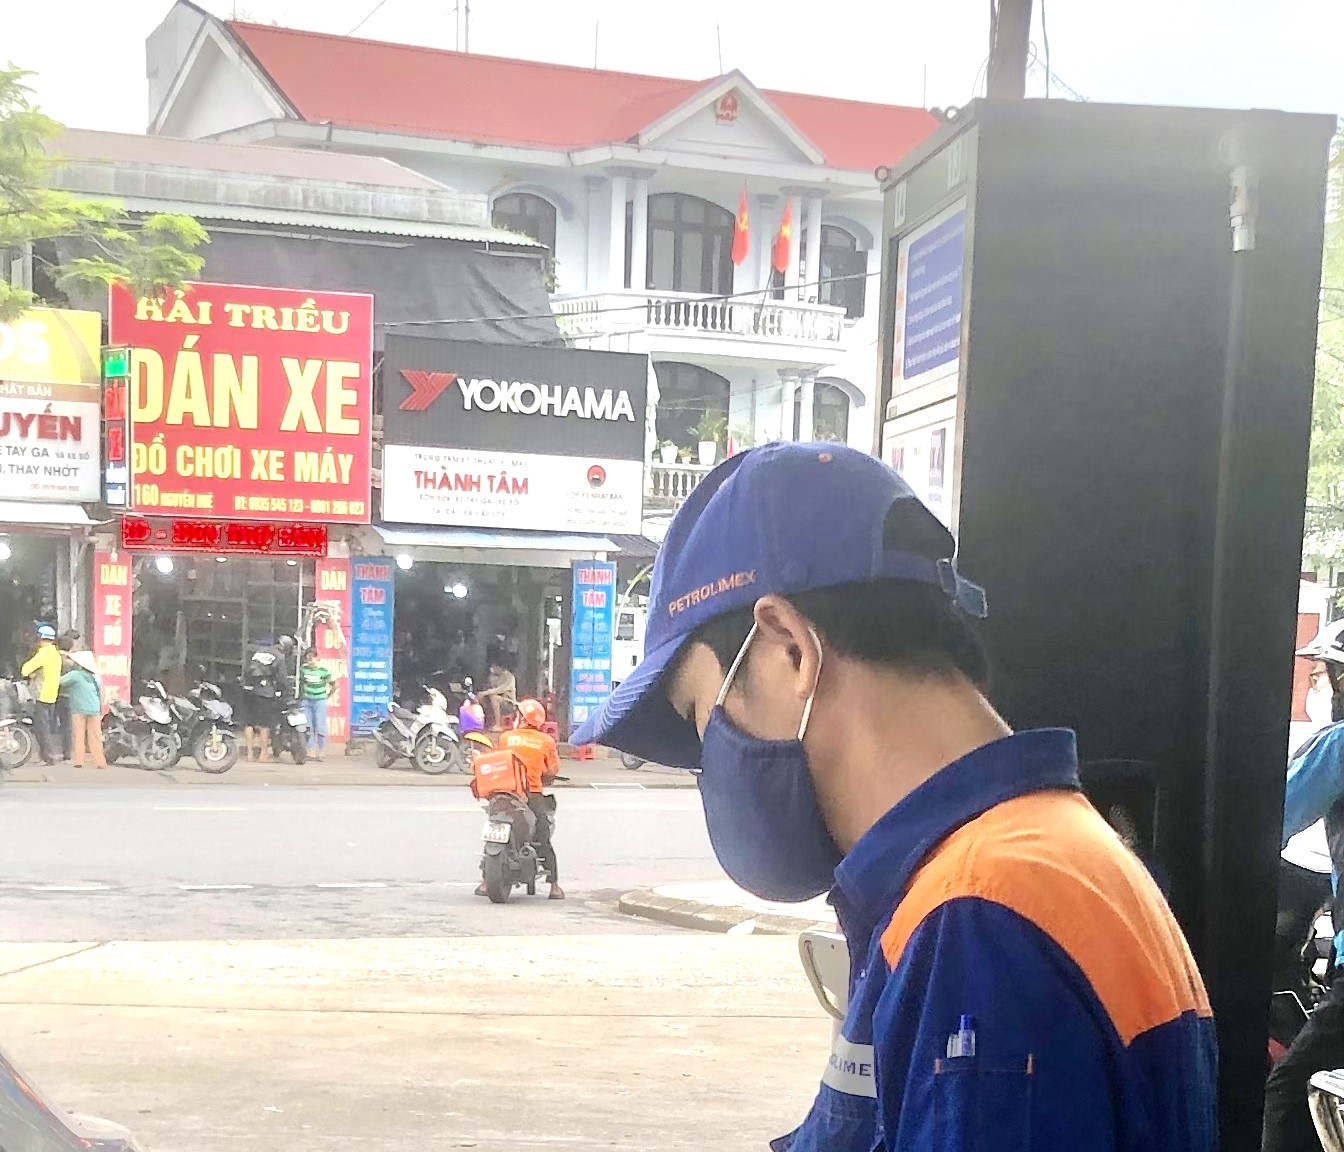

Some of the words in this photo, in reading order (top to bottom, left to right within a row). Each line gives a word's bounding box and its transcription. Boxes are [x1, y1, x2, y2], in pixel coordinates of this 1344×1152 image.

[134, 289, 213, 326] HẢI
[223, 298, 351, 335] TRIỀU
[133, 334, 259, 429] DÁN
[280, 357, 360, 435] XE
[457, 377, 636, 422] YOKOHAMA
[5, 446, 27, 456] TAY
[31, 447, 50, 458] GA
[8, 464, 40, 475] THAY
[176, 444, 242, 479] CHƠI
[250, 449, 285, 481] XE
[294, 447, 353, 485] MÁY
[135, 483, 159, 507] 160
[414, 465, 482, 492] THÀNH
[487, 471, 529, 495] TÂM
[668, 568, 758, 618] PETROLIMEX
